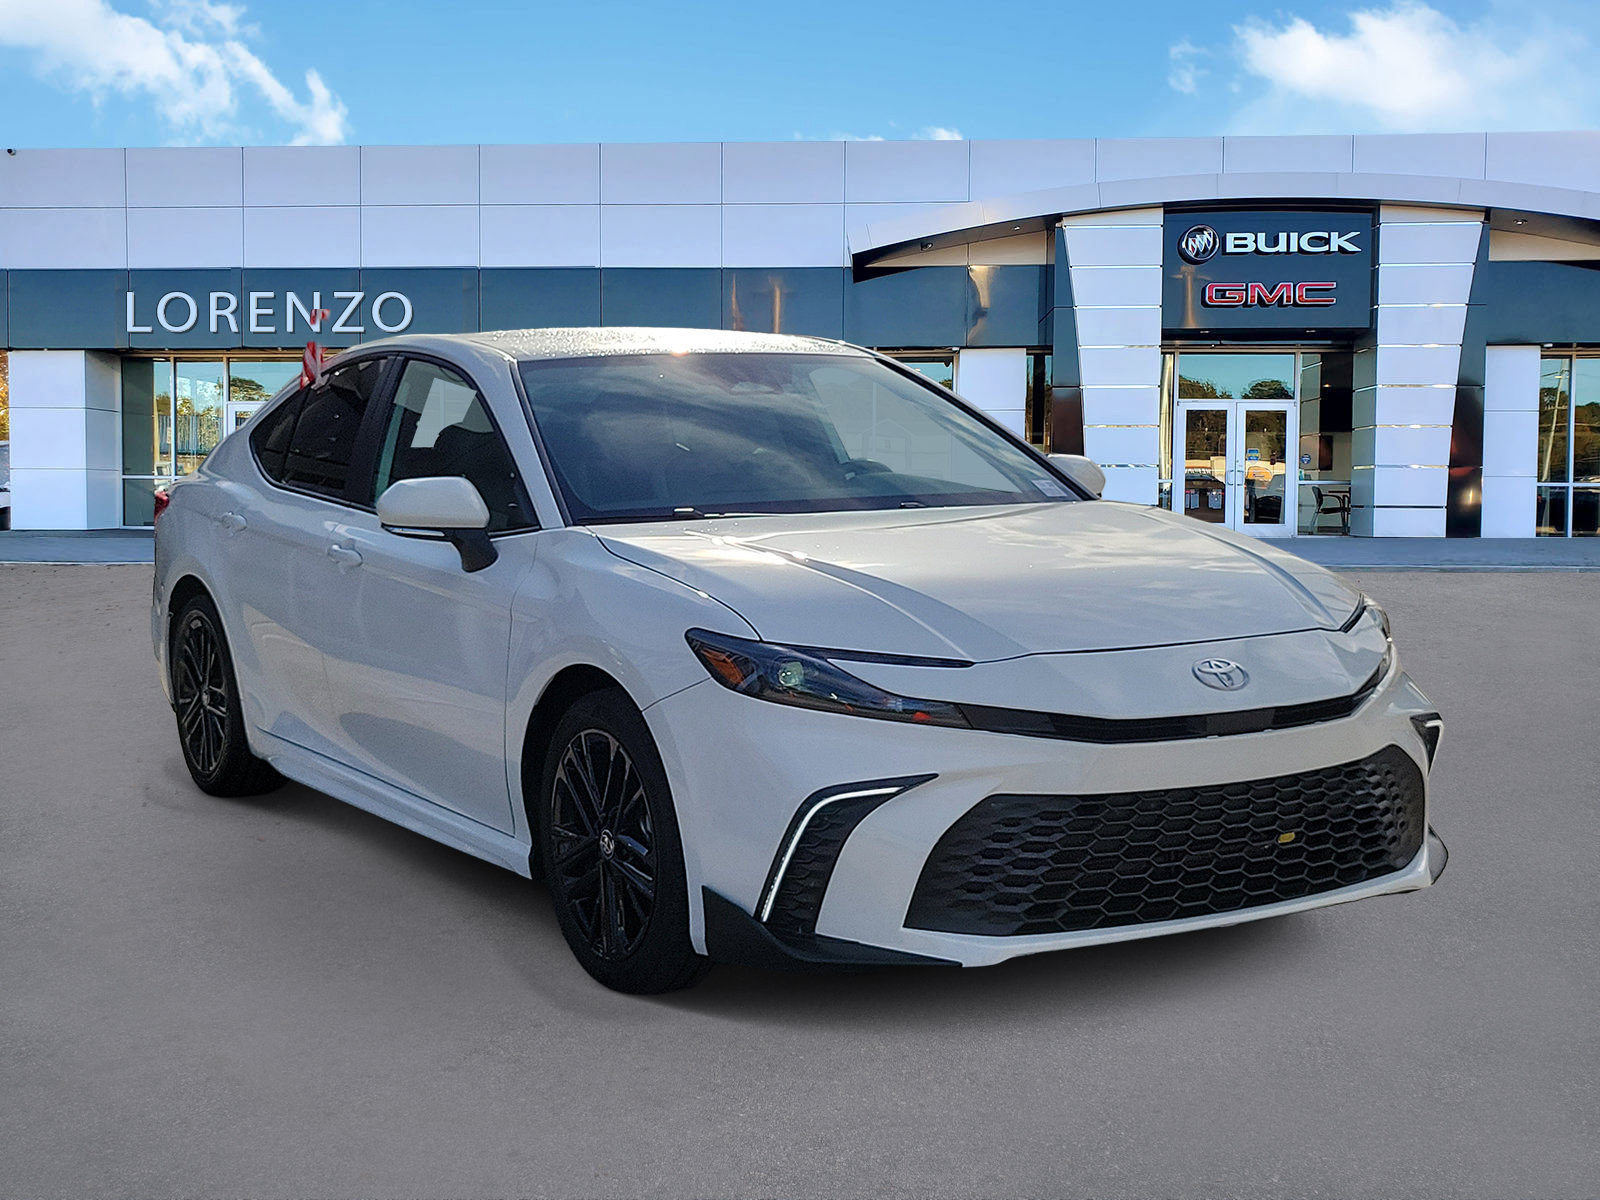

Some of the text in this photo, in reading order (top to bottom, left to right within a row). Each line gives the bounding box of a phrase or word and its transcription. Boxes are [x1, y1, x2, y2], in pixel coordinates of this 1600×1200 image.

[1225, 231, 1362, 253] BUICK
[1205, 281, 1337, 305] GMC
[126, 291, 413, 333] LORENZO
